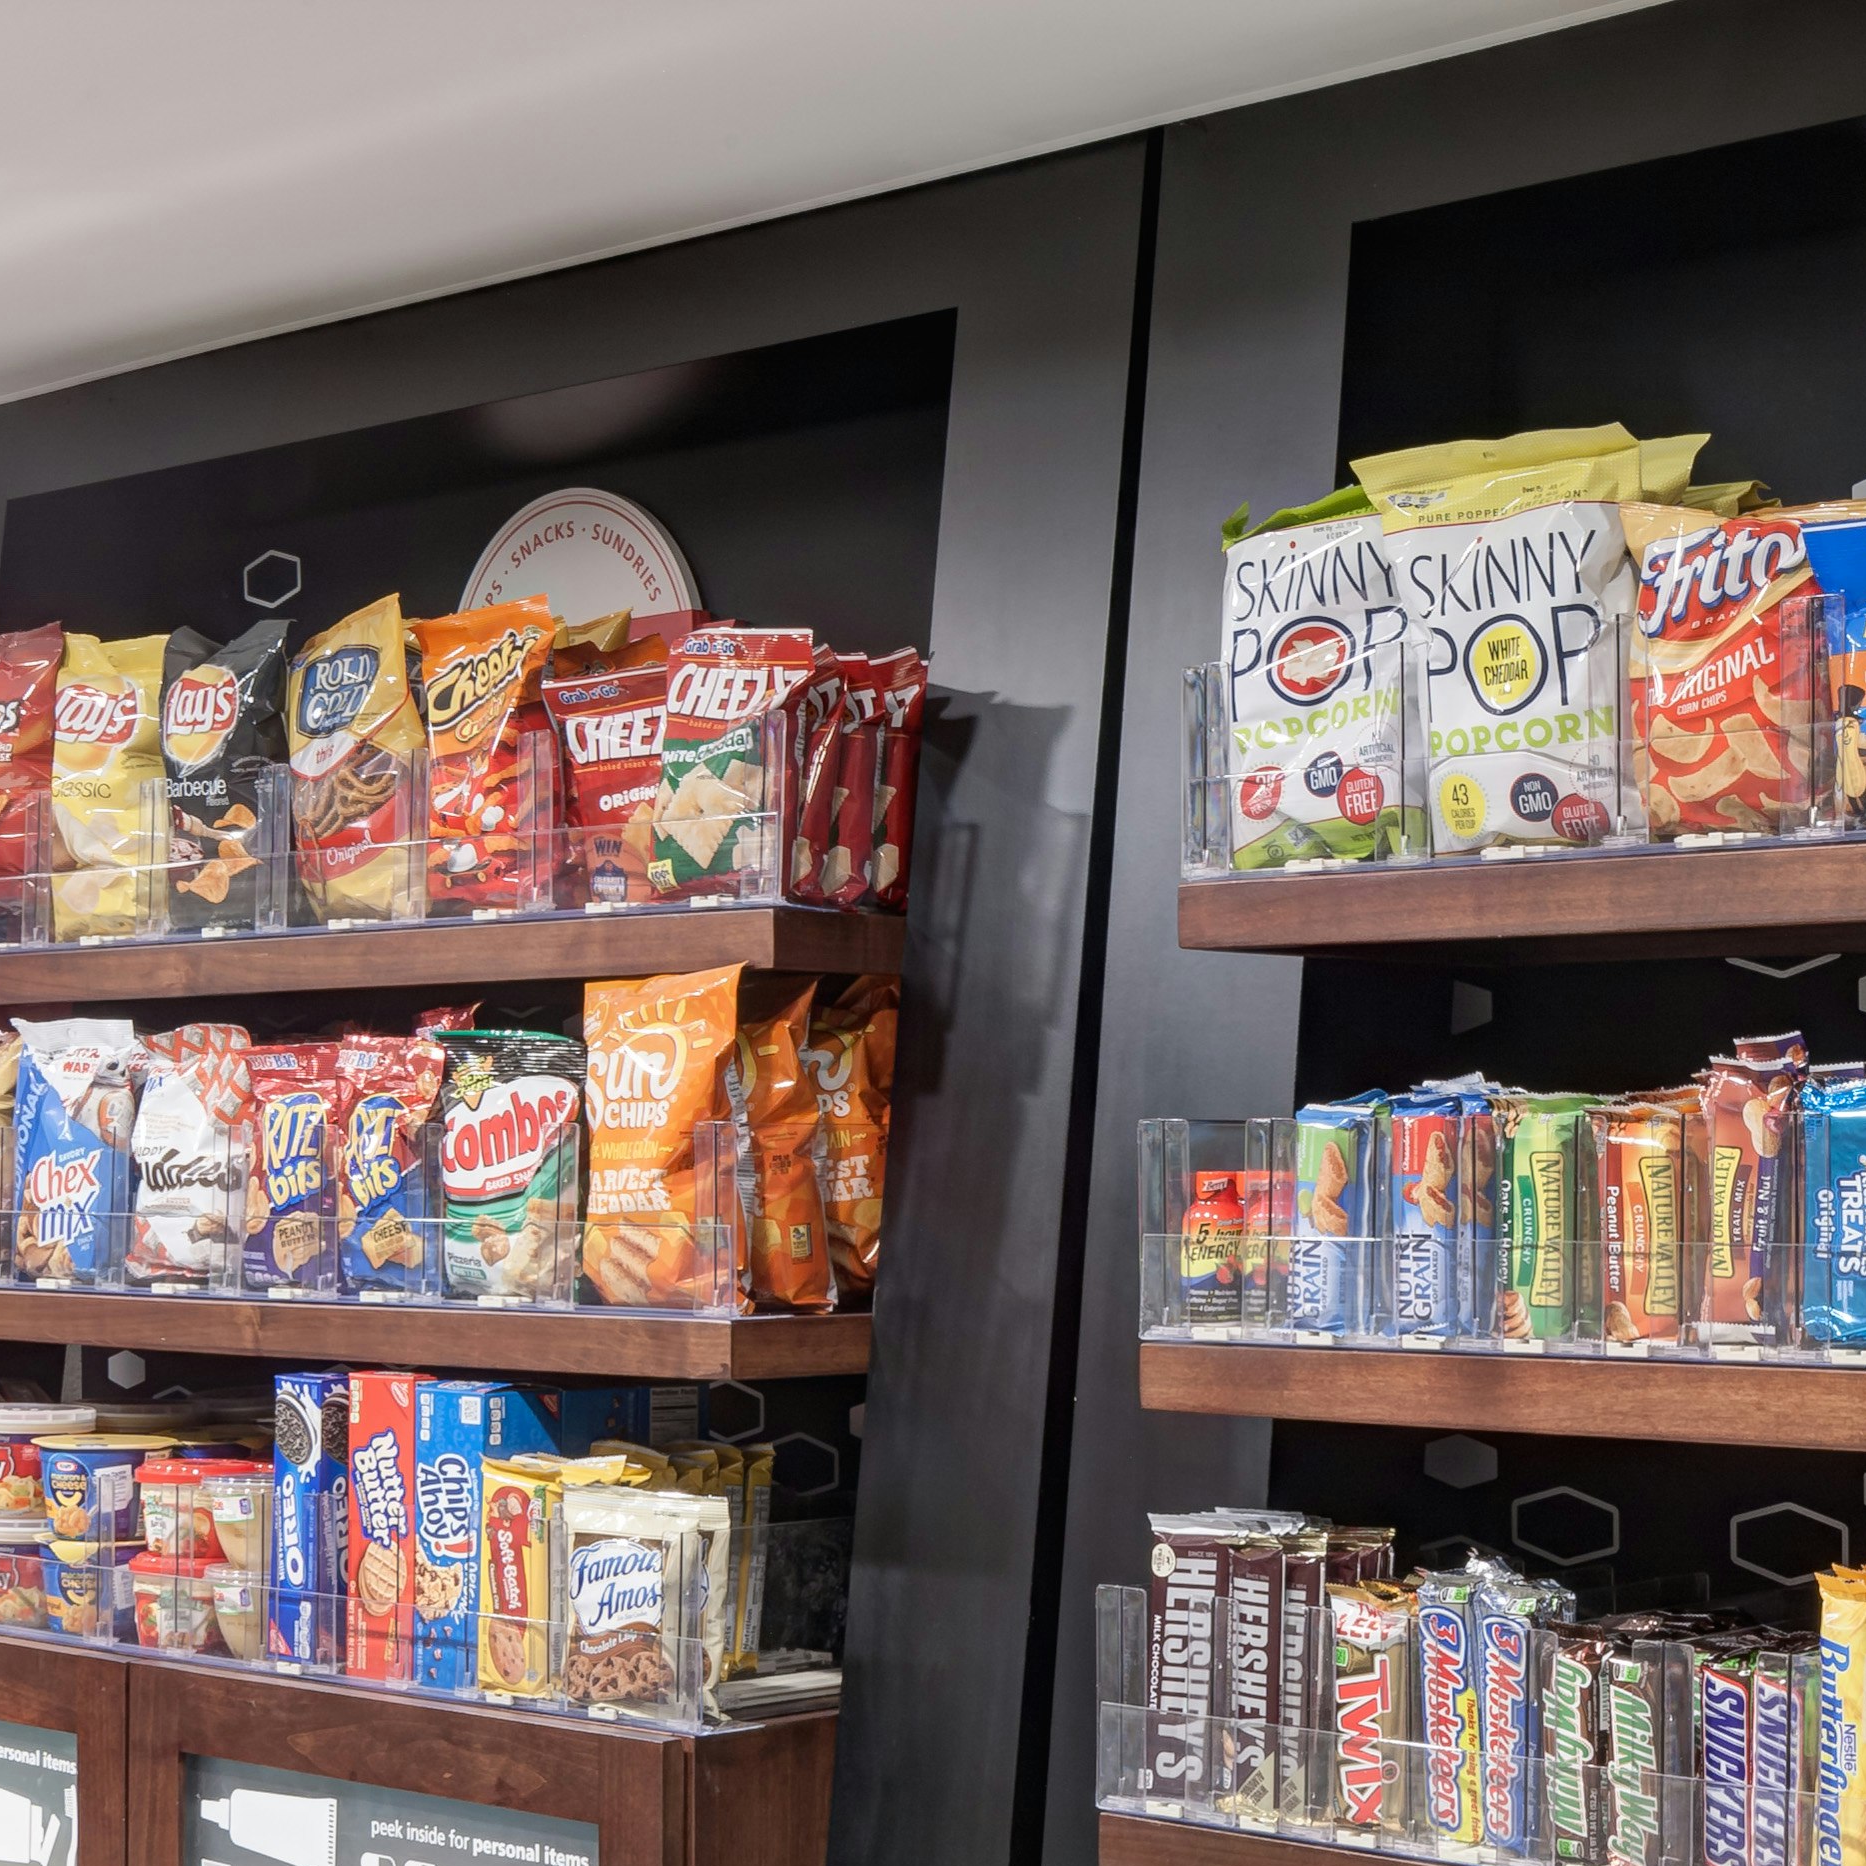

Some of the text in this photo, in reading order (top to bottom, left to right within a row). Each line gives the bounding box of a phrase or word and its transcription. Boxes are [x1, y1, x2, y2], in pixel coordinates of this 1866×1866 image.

[510, 521, 576, 570] SNACKS
[592, 523, 661, 603] SUNDRIES
[1231, 604, 1408, 722] POP
[1427, 603, 1602, 722] POP
[1483, 658, 1529, 686] CHEDDAR
[1487, 636, 1521, 661] WHITE
[167, 680, 234, 736] Lay's
[1232, 688, 1399, 755] POPCORN
[1677, 691, 1727, 716] CORN CHIPS
[51, 777, 111, 799] Classic
[165, 778, 227, 798] Barbecue
[1452, 783, 1469, 804] 43
[1518, 789, 1552, 813] GMO
[326, 830, 373, 865] Original
[263, 1102, 326, 1169] RITZ
[604, 1100, 670, 1129] CHIPS
[34, 1151, 101, 1202] Chex
[268, 1159, 324, 1209] bits
[1606, 1186, 1621, 1292] Peanut Butter
[1733, 1179, 1745, 1243] TRAIL MIX
[447, 1253, 482, 1268] Pizzeria
[354, 1450, 391, 1546] Butter
[371, 1432, 407, 1538] Nutter
[437, 1456, 469, 1539] Chips
[282, 1474, 305, 1587] OREO
[497, 1529, 521, 1611] Soft Batch
[570, 1549, 663, 1600] Famous
[588, 1582, 663, 1627] Amos
[1232, 1577, 1269, 1768] HERSHEY'S
[1337, 1658, 1390, 1824] TWIX
[1422, 1616, 1463, 1833] 3 Musketeers
[371, 1819, 403, 1839] peek
[406, 1824, 445, 1848] inside
[449, 1830, 470, 1851] for
[472, 1836, 541, 1864] personal
